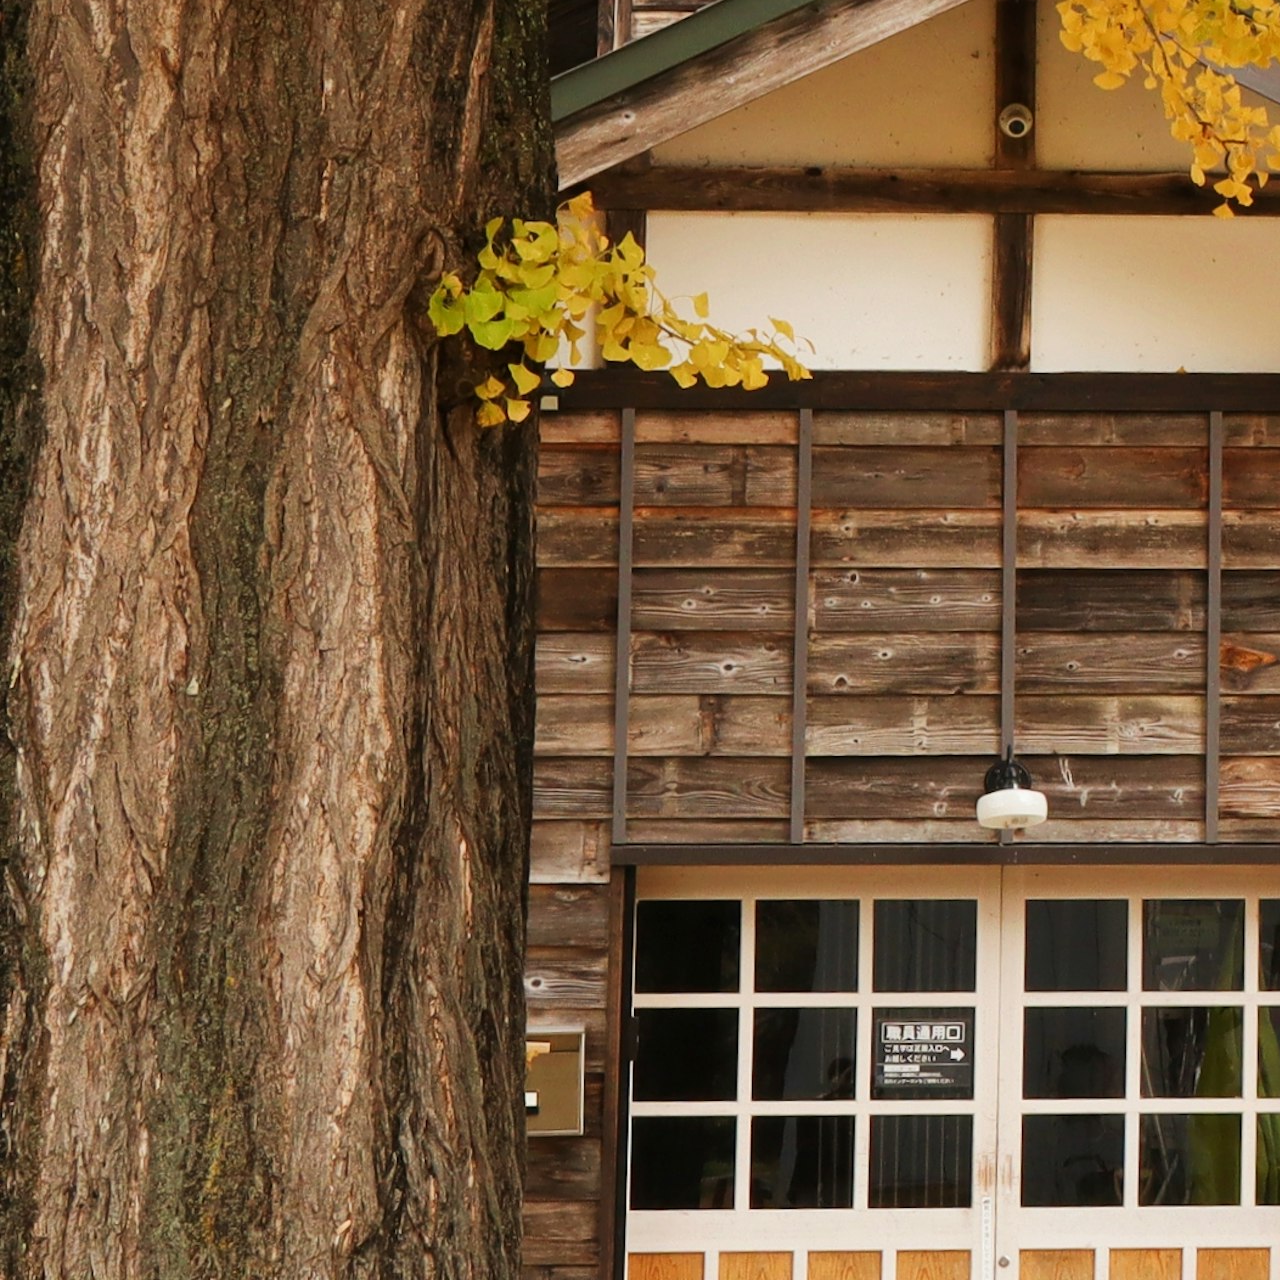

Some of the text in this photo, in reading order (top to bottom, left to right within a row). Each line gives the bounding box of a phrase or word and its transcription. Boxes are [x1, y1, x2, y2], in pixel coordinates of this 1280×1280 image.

[886, 1025, 961, 1040] 職員通用口
